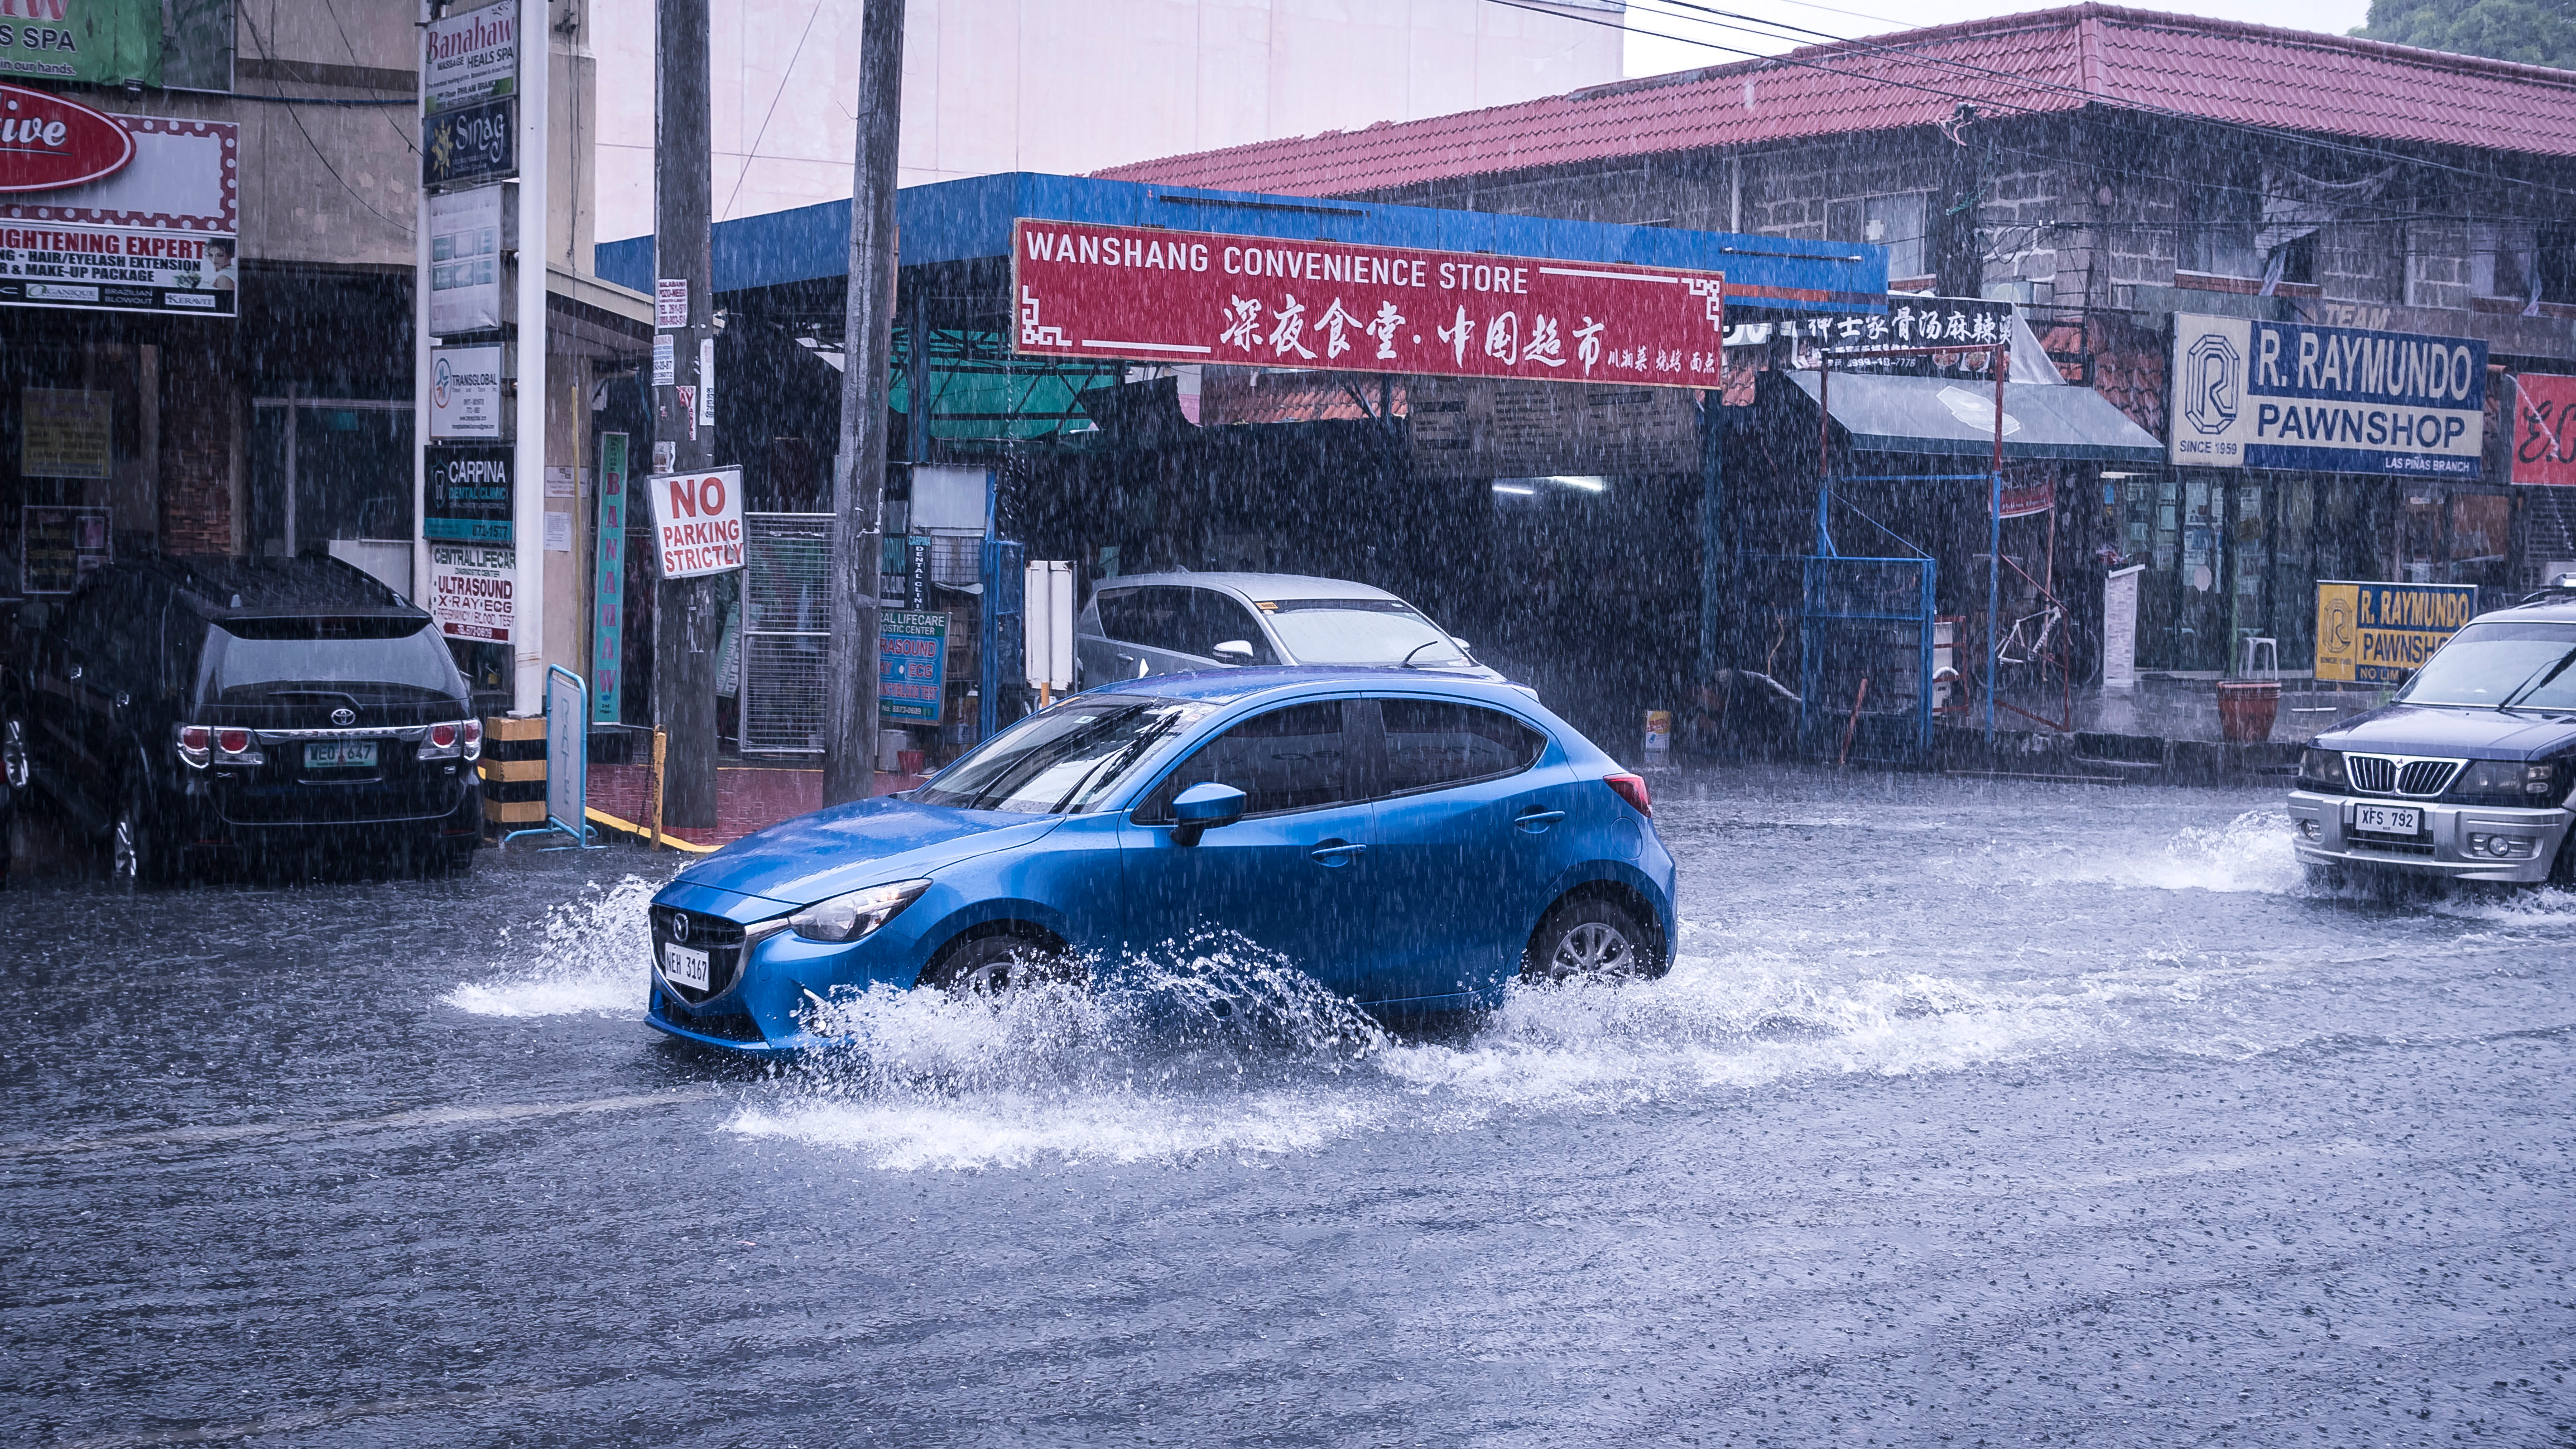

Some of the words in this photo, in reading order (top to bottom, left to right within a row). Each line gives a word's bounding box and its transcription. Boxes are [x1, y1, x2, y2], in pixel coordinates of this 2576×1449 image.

[22, 26, 76, 52] SPA
[427, 16, 515, 61] Banahaw
[14, 61, 35, 71] our
[37, 60, 76, 75] hands.
[438, 56, 464, 71] MASSAGE
[467, 50, 494, 69] HEALS
[496, 46, 514, 62] SPA
[0, 99, 66, 147] ive
[455, 113, 506, 163] Sinag
[126, 236, 206, 260] EXPERT
[25, 263, 89, 279] MAKE-UP
[92, 267, 155, 282] PACKAGE
[28, 251, 126, 267] HAIR/EYELASH
[129, 256, 201, 272] EXTENSION
[1026, 231, 1208, 272] WANSHANG
[1224, 246, 1426, 287] CONVENIENCE
[1439, 261, 1529, 295] STORE
[105, 288, 153, 297] BRAZILIAN
[166, 295, 213, 305] KERAVIT
[105, 296, 153, 304] BLOWOUT
[2325, 304, 2391, 330] TEAM
[2258, 329, 2287, 387] R.
[2298, 332, 2472, 401] RAYMUNDO
[452, 373, 497, 386] TRANSGLOBAL
[2258, 403, 2466, 448] PAWNSHOP
[2180, 440, 2212, 454] SINCE
[2215, 442, 2237, 455] 1959
[448, 460, 506, 483] CARPINA
[2385, 457, 2404, 469] LAS
[2405, 456, 2431, 471] PIÑAS
[2433, 459, 2469, 473] BRANCH
[449, 487, 478, 500] DENTAL
[480, 487, 506, 500] CLINIC
[670, 477, 725, 519] NO
[663, 519, 739, 548] PARKING
[434, 548, 475, 567] CENTRAL
[665, 543, 744, 573] STRICTLY
[915, 546, 924, 579] DENTAL
[438, 575, 512, 599] ULTRASOUND
[598, 472, 621, 693] BANAHAW
[484, 599, 512, 613] ECG
[2360, 590, 2375, 624] R.
[2380, 591, 2469, 628] RAYMUNDO
[498, 614, 515, 627] TEST
[881, 623, 905, 634] OSTIC
[905, 625, 935, 636] CENTER
[897, 613, 945, 627] LIFECARE
[909, 663, 933, 678] ECG
[2360, 668, 2377, 680] NO
[921, 687, 938, 700] TEST
[2362, 810, 2383, 825] XFS
[2391, 812, 2413, 828] 792
[666, 951, 681, 975] NEH
[686, 956, 707, 982] 3167
